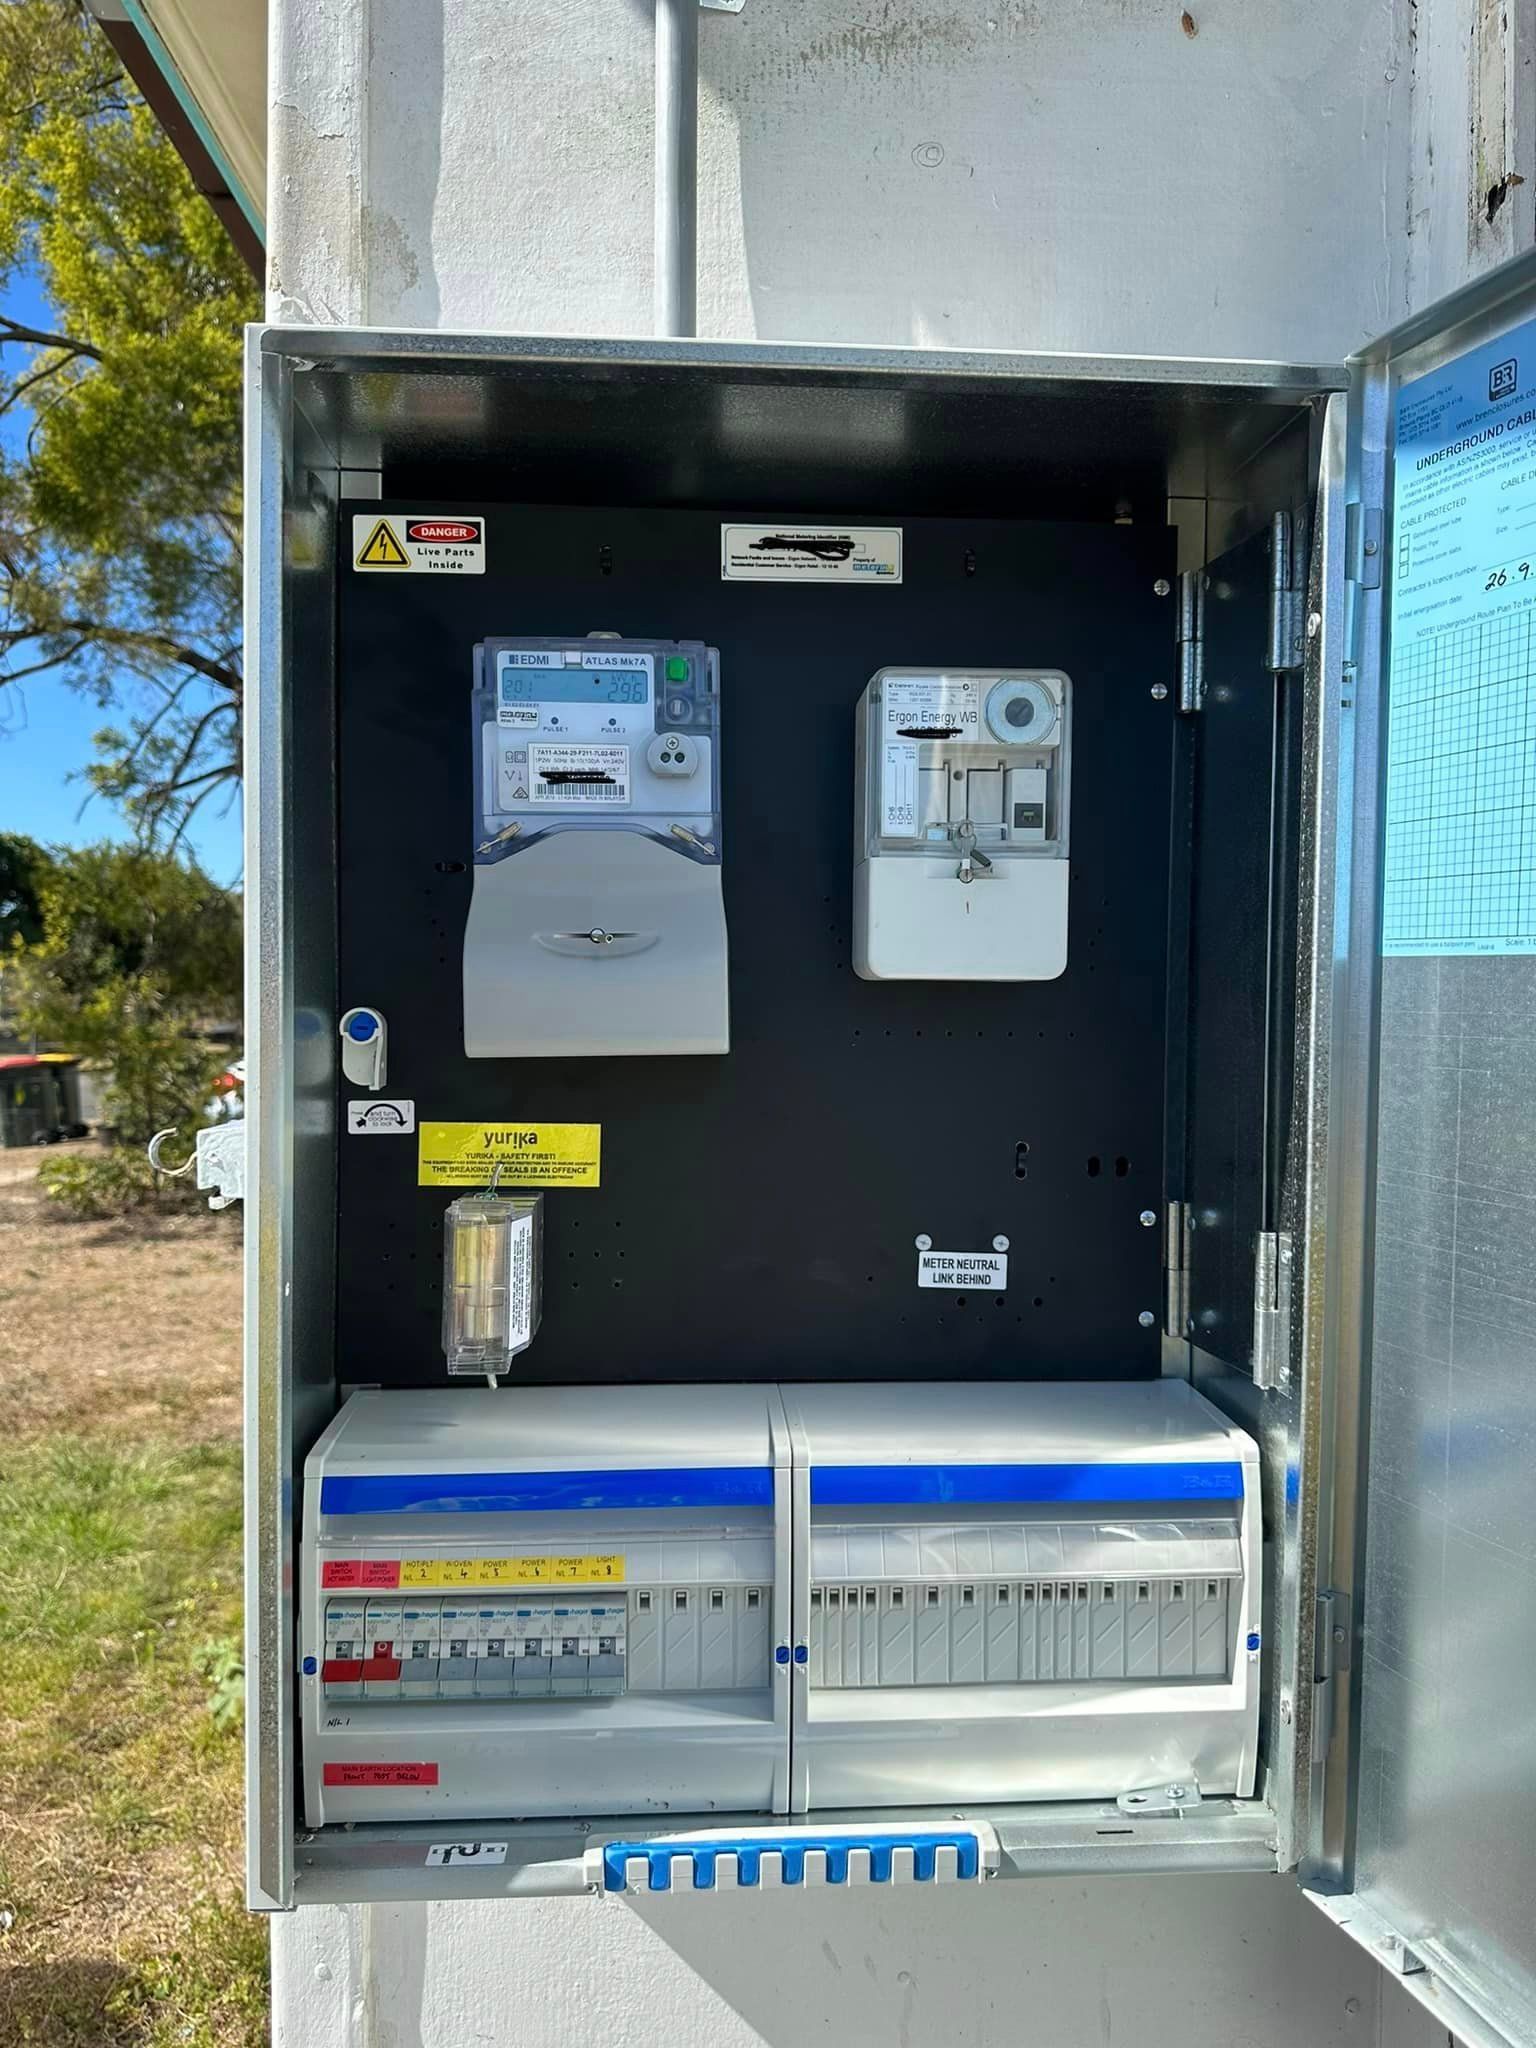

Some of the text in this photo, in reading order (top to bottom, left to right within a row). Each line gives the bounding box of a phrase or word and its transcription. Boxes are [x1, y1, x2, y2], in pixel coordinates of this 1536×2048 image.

[1416, 424, 1504, 471] UNDERGROUND
[1501, 473, 1527, 490] CABLE
[1401, 496, 1467, 530] CABLE PROTECTED
[421, 528, 467, 537] DANGER
[418, 548, 475, 557] Live Parts
[429, 561, 464, 569] Inside
[521, 656, 549, 665] EDMI
[586, 657, 647, 666] ATLAS Mk7A
[888, 710, 978, 726] Ergon Energy WB
[484, 1132, 538, 1149] yurika
[450, 1166, 489, 1174] BREAKING
[552, 1167, 588, 1175] OFFENCE
[923, 1257, 1000, 1271] METER NEUTRAL
[932, 1272, 992, 1285] LINK BEHIND
[483, 1560, 508, 1568] POWER
[558, 1558, 583, 1566] POWER
[420, 1568, 427, 1578] 2
[460, 1568, 468, 1579] 4
[494, 1568, 499, 1577] 5
[571, 1567, 577, 1576] 7
[606, 1565, 612, 1576] 8
